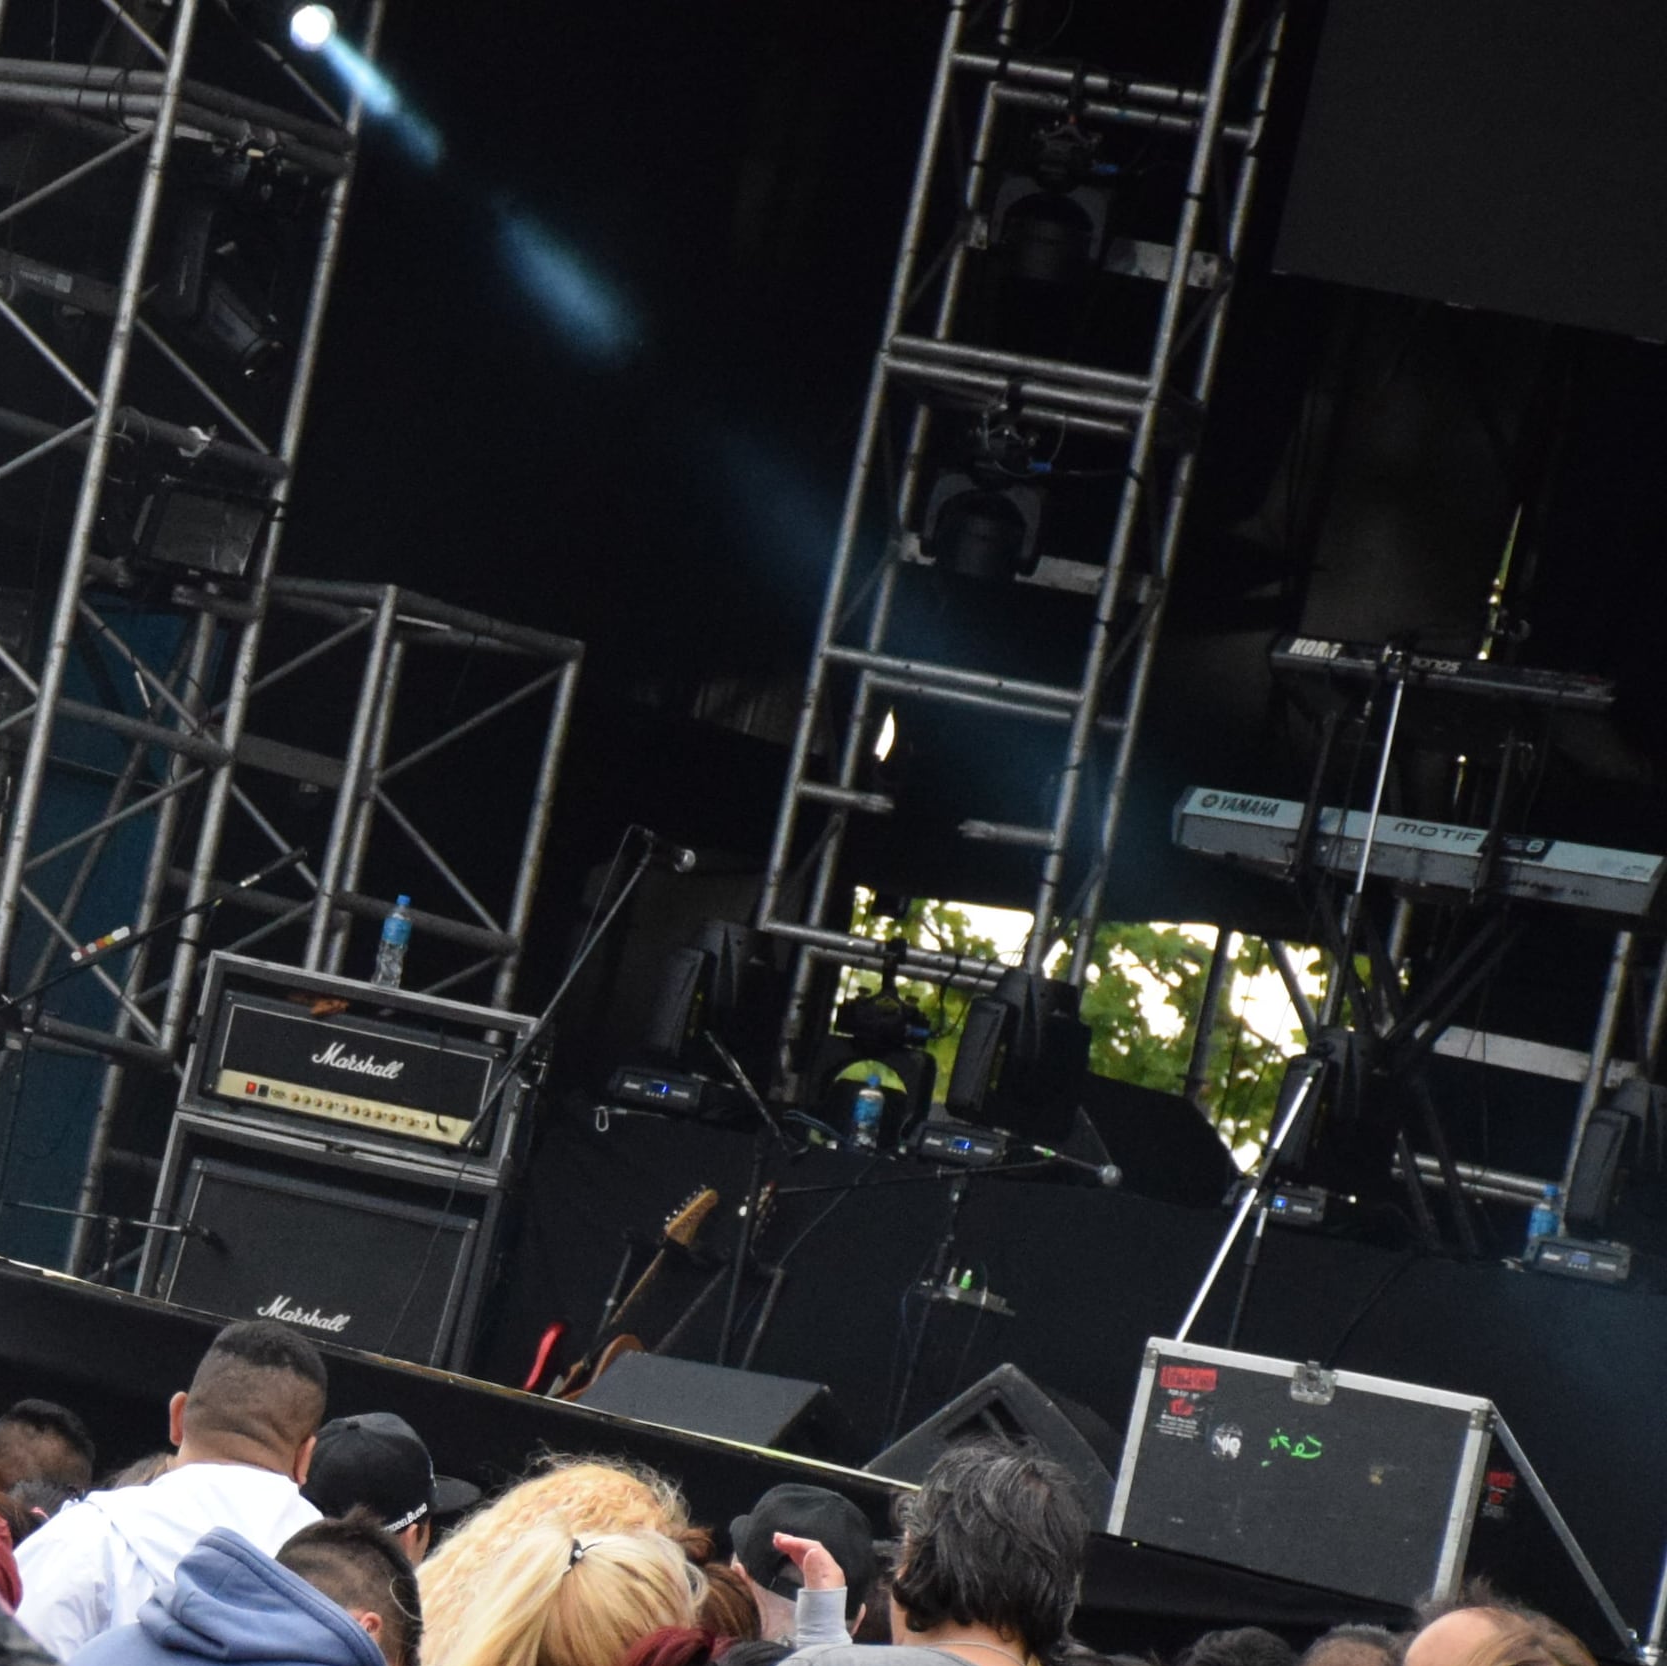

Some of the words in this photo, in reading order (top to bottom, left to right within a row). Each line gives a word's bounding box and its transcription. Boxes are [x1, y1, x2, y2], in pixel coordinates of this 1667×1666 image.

[1219, 795, 1281, 817] YAMAHA
[1394, 821, 1482, 842] MOTIF
[312, 1042, 405, 1079] Marshall
[257, 1294, 351, 1332] Marshall
